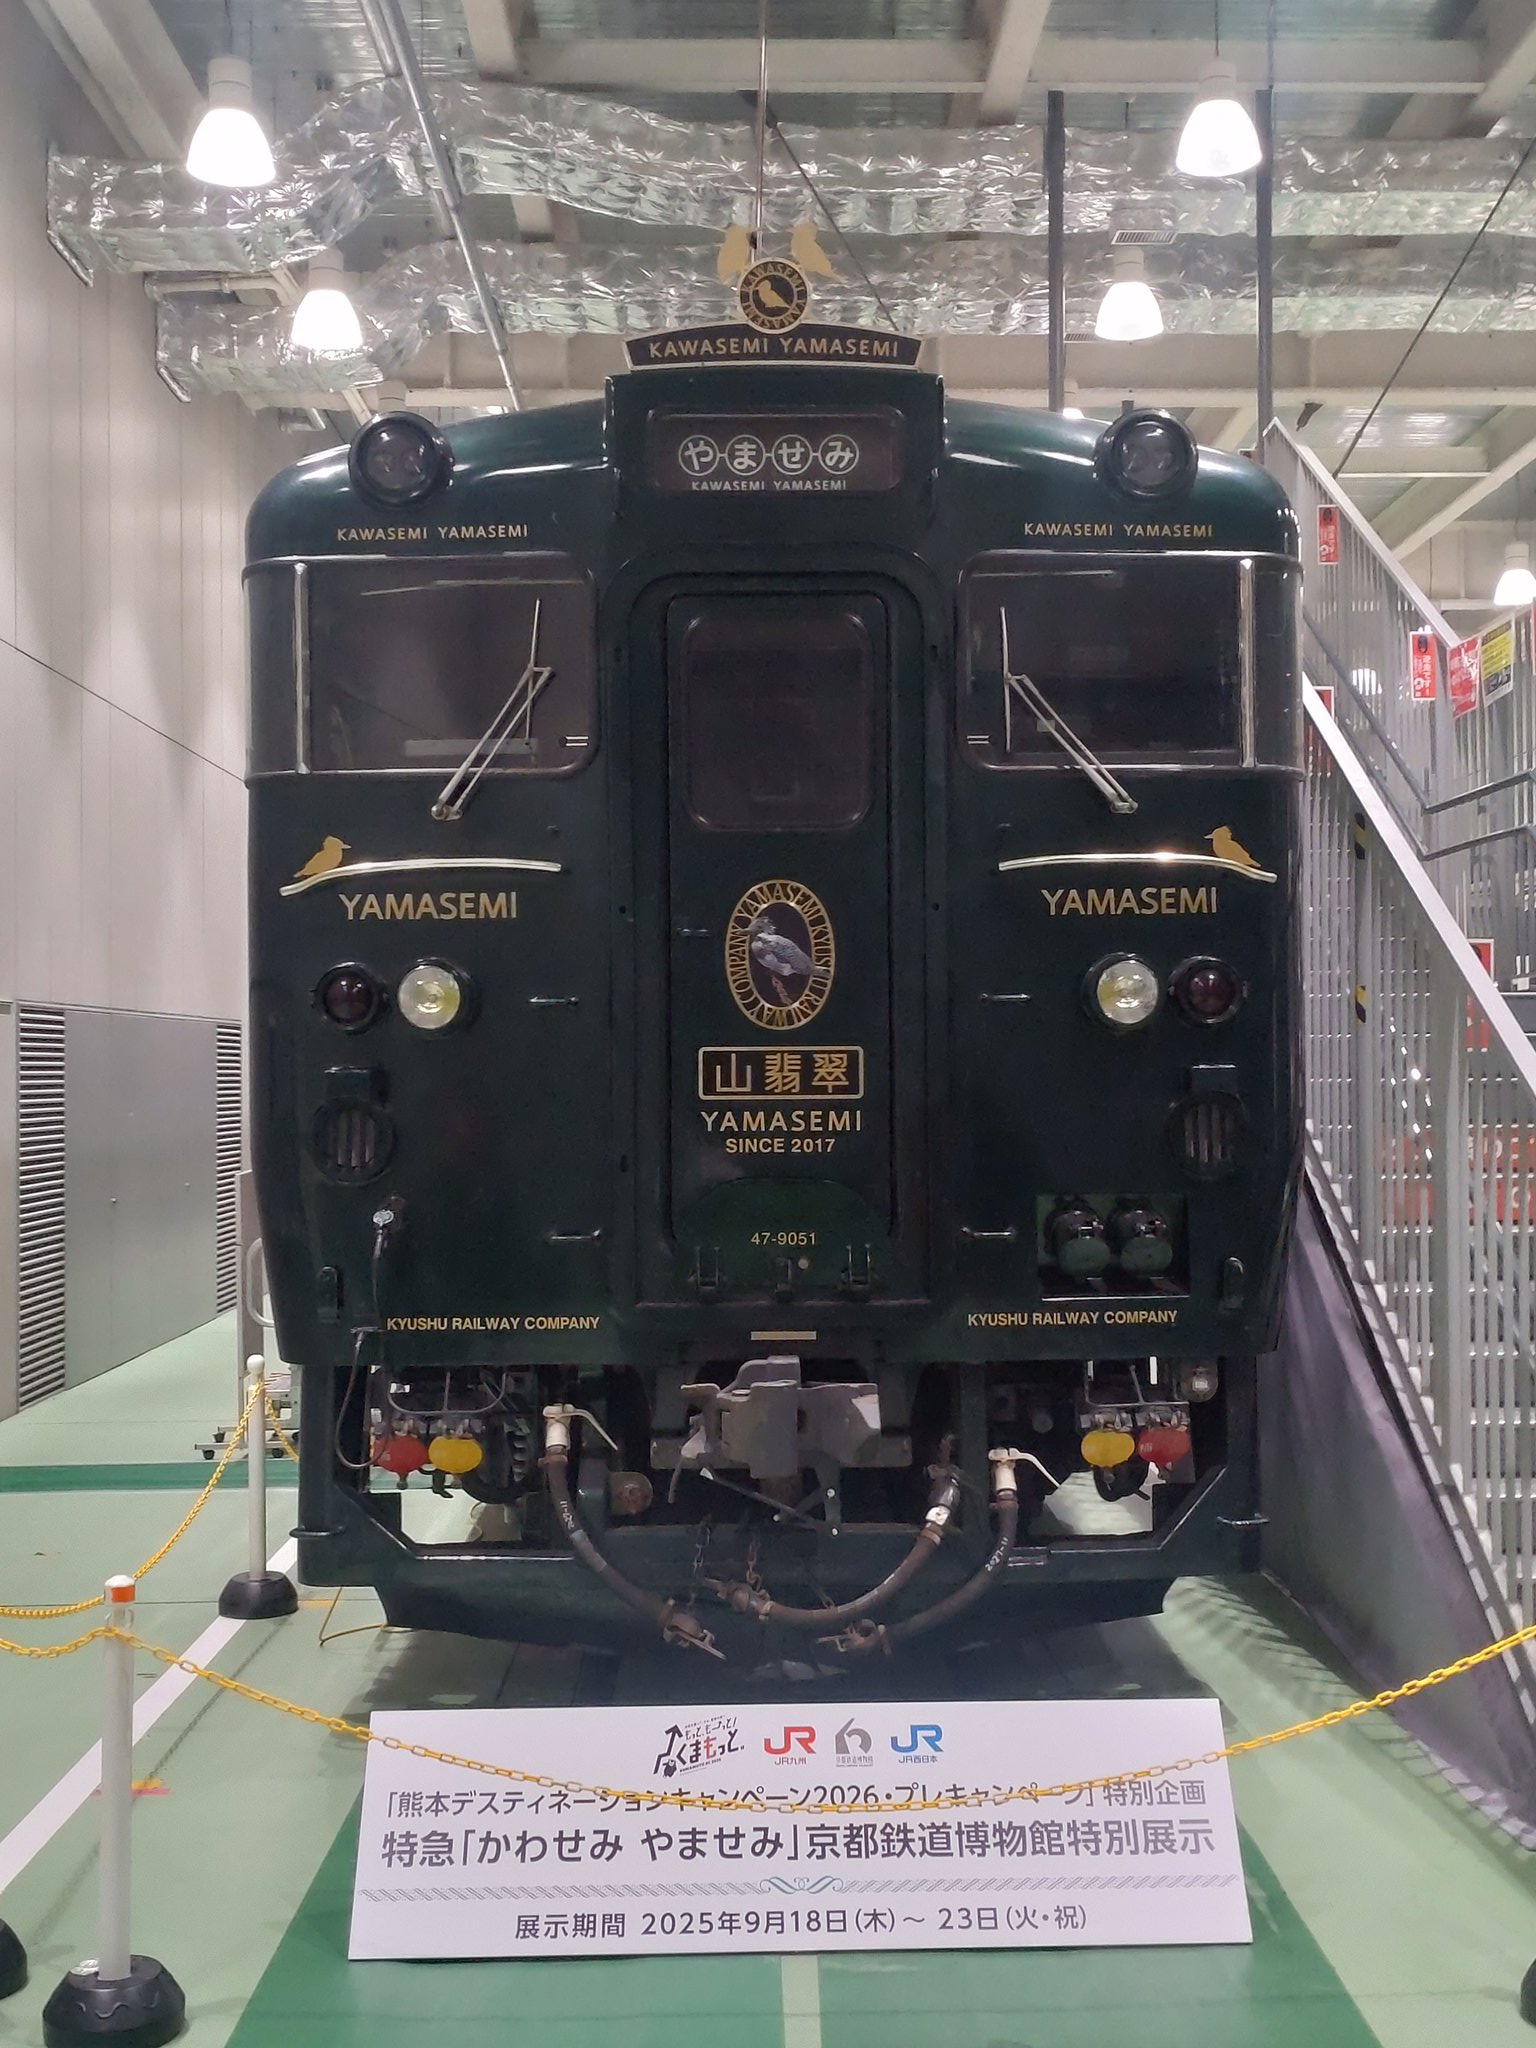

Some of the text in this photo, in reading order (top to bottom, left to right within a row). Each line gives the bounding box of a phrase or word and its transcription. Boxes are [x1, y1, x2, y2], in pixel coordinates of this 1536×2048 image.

[649, 337, 898, 358] KAWASEMI YAMASEMI
[683, 439, 855, 472] やませみ
[692, 480, 847, 491] KAWASEMI YAMASEMI
[337, 524, 528, 542] KAWASEMI YAMASEMI
[1024, 522, 1213, 538] KAWASEMI YAMASEMI
[339, 891, 518, 921] YAMASEMI
[735, 882, 825, 926] YAMASEMI
[1040, 886, 1218, 916] YAMASEMI
[728, 924, 751, 1005] COMPANY
[750, 993, 822, 1027] RAILWAY
[714, 1051, 850, 1094] 山翡翠
[700, 1109, 862, 1132] YAMASEMI
[725, 1138, 836, 1153] SINCE 2017
[750, 1231, 817, 1246] 47-9051
[386, 1316, 600, 1331] KYUSHU RAILWAY COMPANY
[967, 1310, 1178, 1327] KYUSHU RAILWAY COMPANY
[763, 1726, 817, 1755] JR
[890, 1724, 944, 1753] JR
[774, 1756, 807, 1766] JR九州
[898, 1755, 938, 1764] JR西日本
[381, 1818, 1216, 1868] 特急「かわせみ やませみ」京都鉄道博物館特別展示
[514, 1912, 626, 1940] 展示期間
